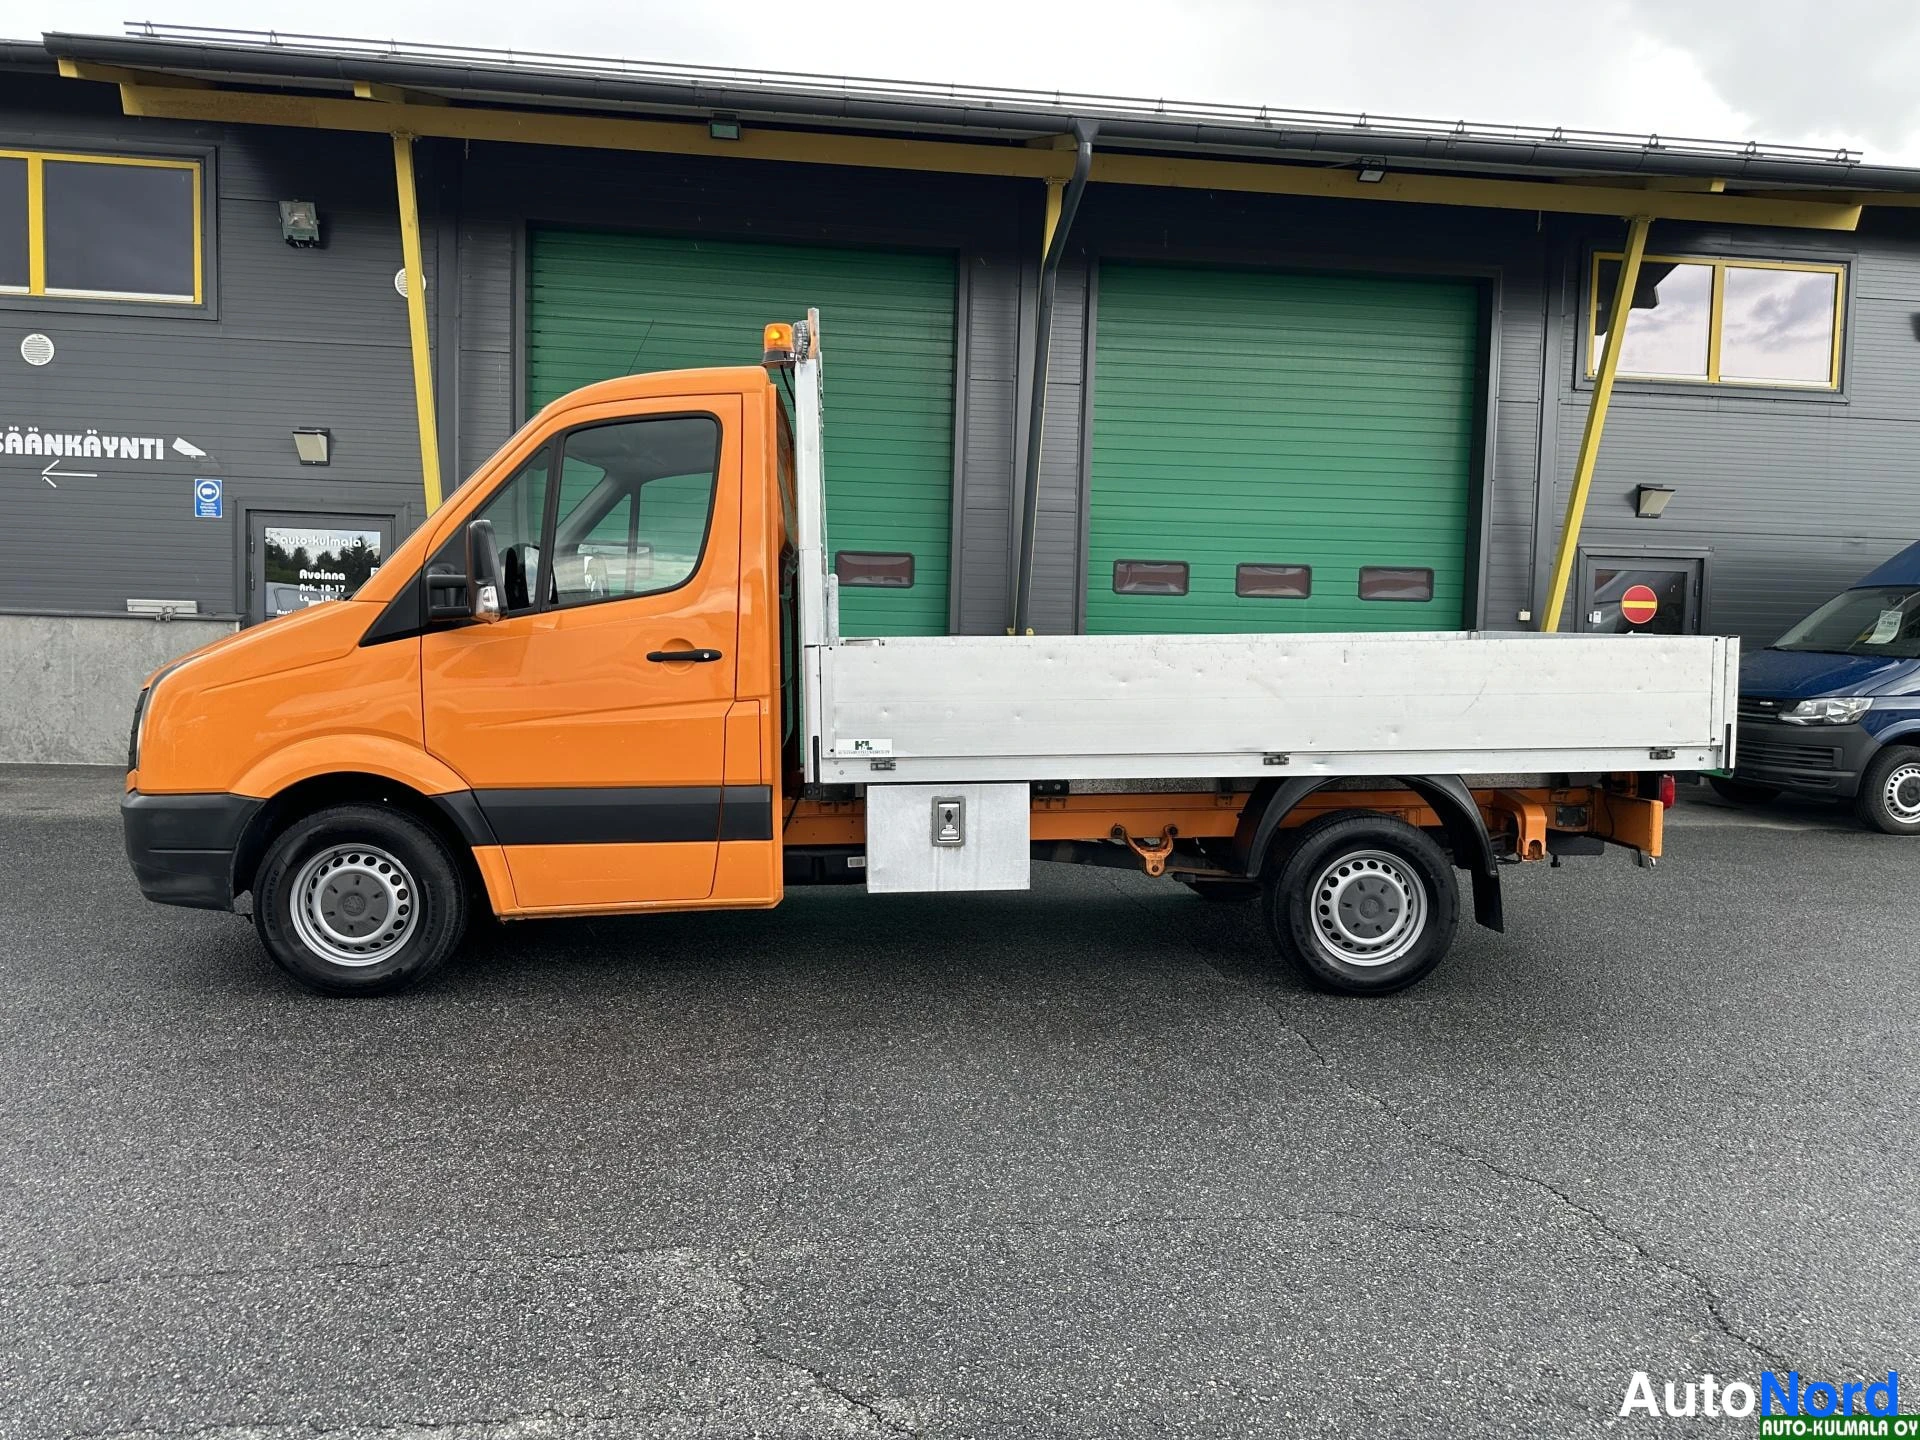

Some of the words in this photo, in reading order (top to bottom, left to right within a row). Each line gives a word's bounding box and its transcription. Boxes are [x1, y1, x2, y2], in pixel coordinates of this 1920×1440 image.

[0, 426, 164, 460] ÄÄNKÄYNTI
[280, 535, 362, 548] auto-kulmala
[299, 568, 346, 581] Avoinna
[320, 584, 346, 593] 10-17
